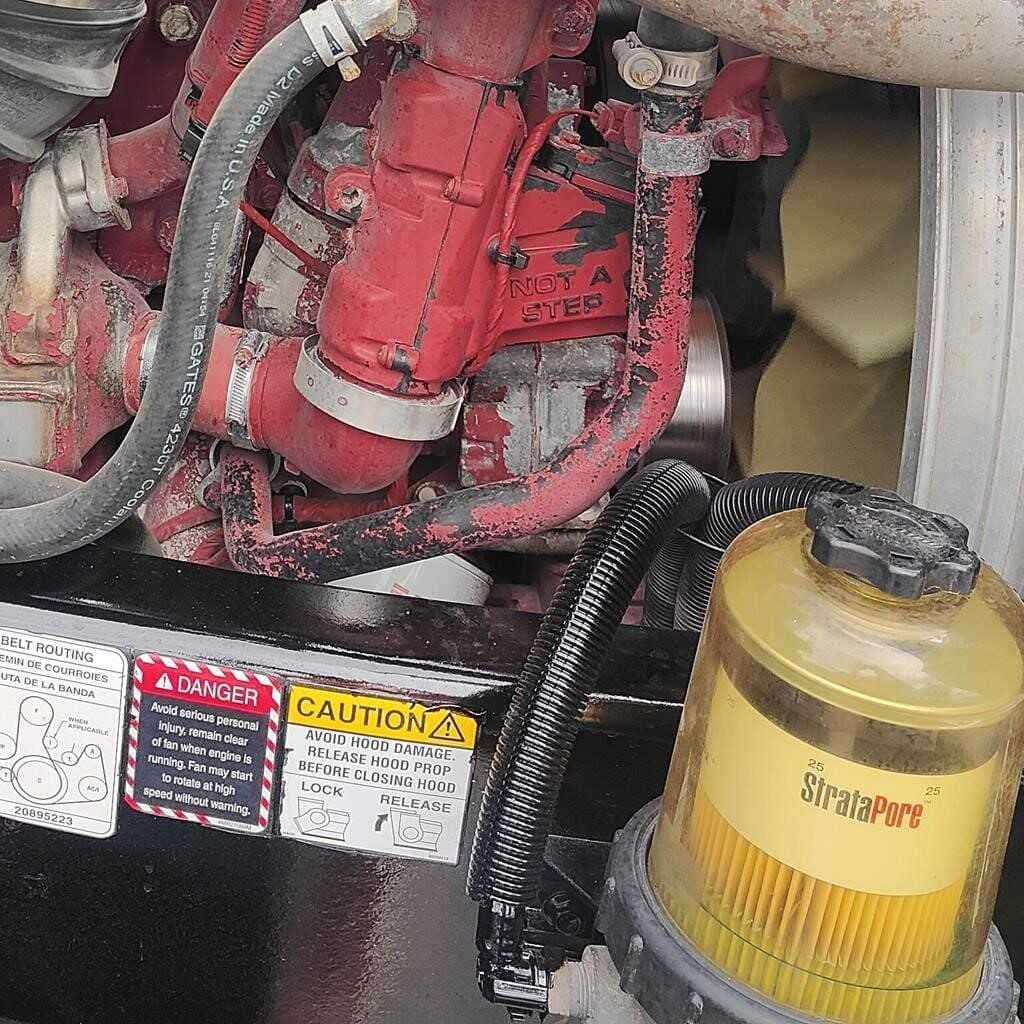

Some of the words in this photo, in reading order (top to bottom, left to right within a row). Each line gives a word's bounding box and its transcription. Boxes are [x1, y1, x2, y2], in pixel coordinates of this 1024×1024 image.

[276, 65, 303, 90] D2
[245, 89, 282, 135] Made
[234, 137, 250, 155] in
[215, 159, 244, 213] U.S.A.
[509, 269, 576, 299] NOT
[589, 264, 613, 287] A
[521, 292, 604, 323] STEP
[152, 423, 182, 476] 4230T
[0, 635, 33, 651] BELT
[36, 642, 94, 663] ROUTING
[27, 659, 42, 670] DE
[45, 663, 109, 683] COURROIES
[24, 678, 39, 687] DE
[41, 681, 56, 691] LA
[58, 684, 96, 698] BANDA
[177, 675, 259, 707] DANGER
[151, 701, 178, 716] Avoid
[179, 708, 215, 723] serious
[216, 715, 259, 731] personal
[297, 696, 426, 733] CAUTION
[158, 720, 188, 736] injury,
[189, 726, 222, 741] remain
[224, 733, 249, 747] clear
[305, 730, 346, 746] AVOID
[351, 736, 389, 752] HOOD
[394, 742, 456, 761] DAMAGE.
[151, 737, 162, 747] of
[162, 738, 178, 750] fan
[181, 743, 207, 756] when
[208, 749, 242, 763] engine
[243, 753, 253, 765] is
[307, 745, 367, 765] RELEASE
[371, 755, 409, 771] HOOD
[414, 761, 451, 777] PROP
[807, 758, 825, 772] 25
[147, 753, 186, 770] running.
[188, 760, 207, 773] Fan
[208, 765, 229, 779] may
[231, 769, 253, 782] start
[298, 760, 350, 778] BEFORE
[354, 769, 413, 788] CLOSING
[417, 777, 456, 794] HOOD
[161, 772, 172, 783] to
[173, 775, 201, 788] rotate
[202, 780, 213, 791] at
[214, 781, 236, 796] high
[301, 781, 344, 798] LOCK
[925, 786, 941, 796] 25
[143, 786, 173, 800] speed
[174, 792, 209, 807] without
[210, 799, 251, 817] warning.
[380, 794, 452, 813] RELEASE
[800, 771, 924, 829] StrataPore
[14, 806, 74, 825] 20895223
